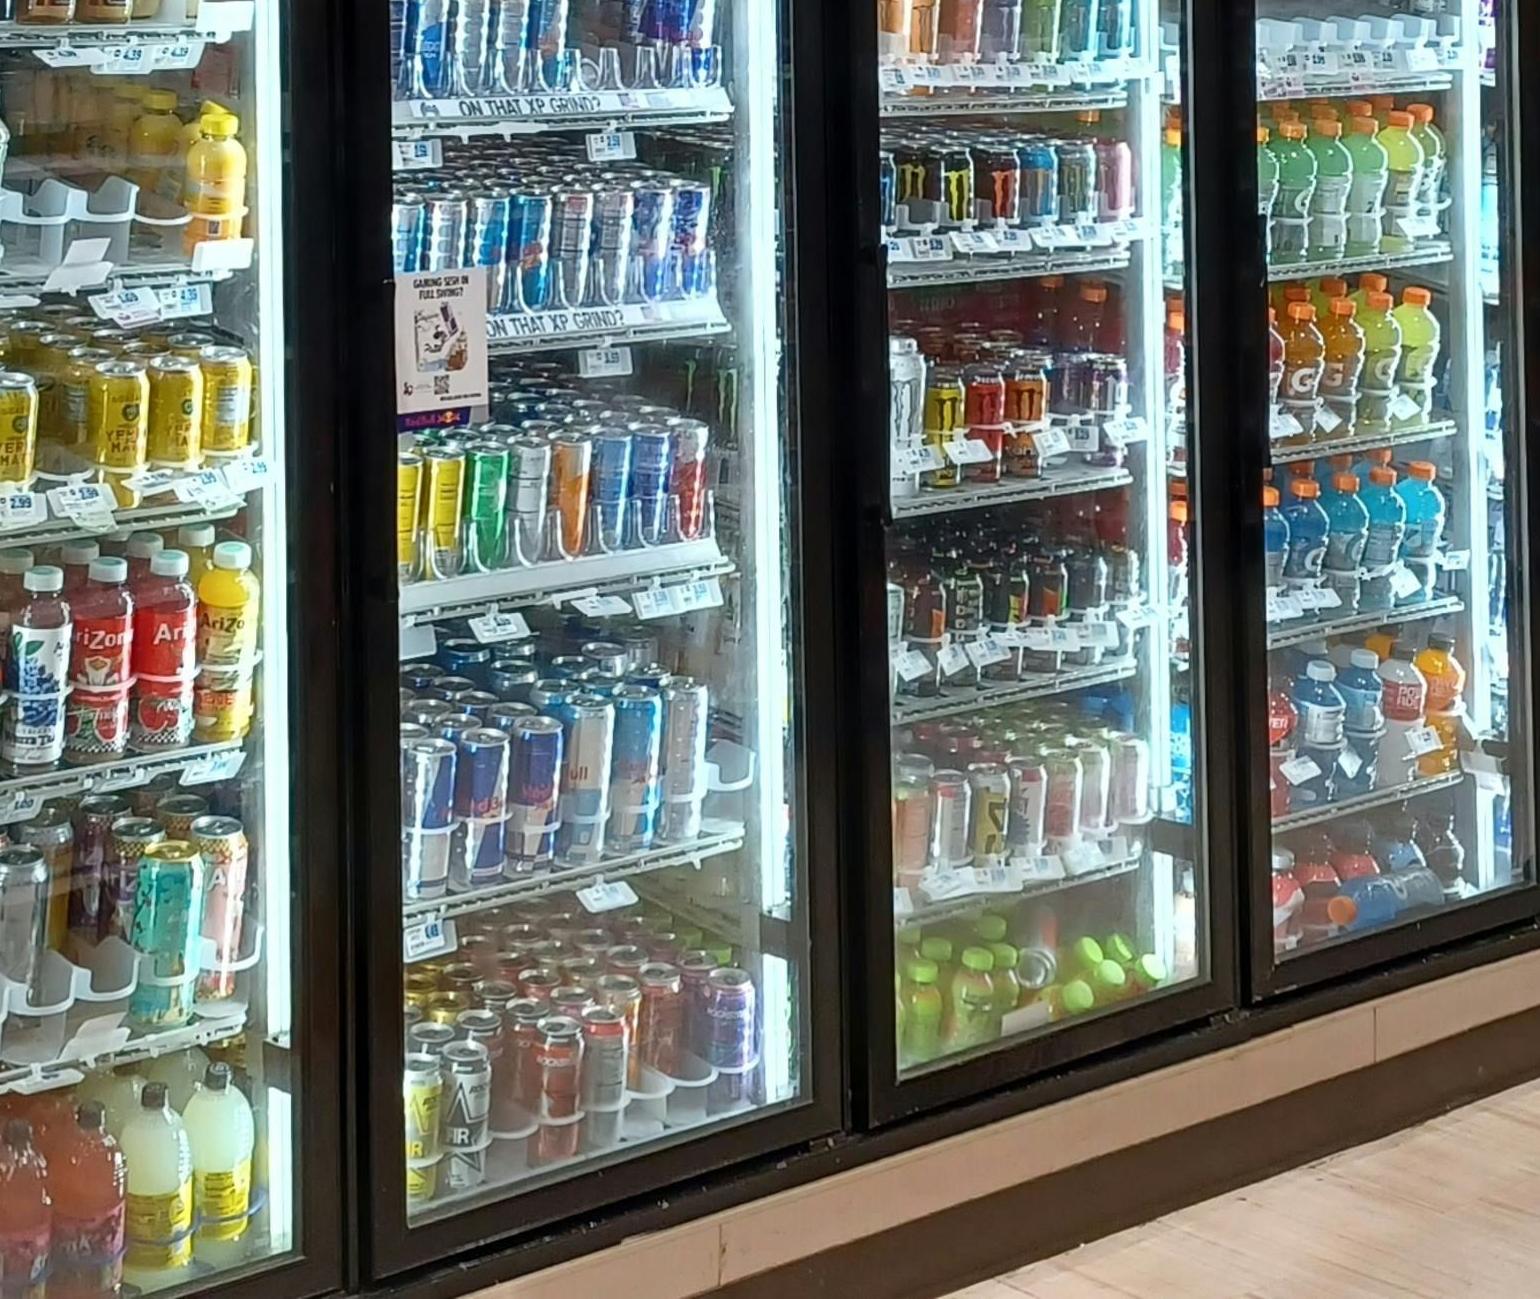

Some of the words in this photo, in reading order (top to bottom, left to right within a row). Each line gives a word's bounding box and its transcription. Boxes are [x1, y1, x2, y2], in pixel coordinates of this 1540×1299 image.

[458, 102, 483, 117] ON
[485, 100, 521, 116] THAT
[527, 100, 546, 115] XP
[549, 97, 600, 114] GRIND?
[486, 318, 506, 337] ON
[508, 316, 546, 335] THAT
[551, 315, 569, 330] XP
[574, 311, 624, 329] GRIND?
[1292, 367, 1317, 394] G
[10, 494, 32, 508] 2.99
